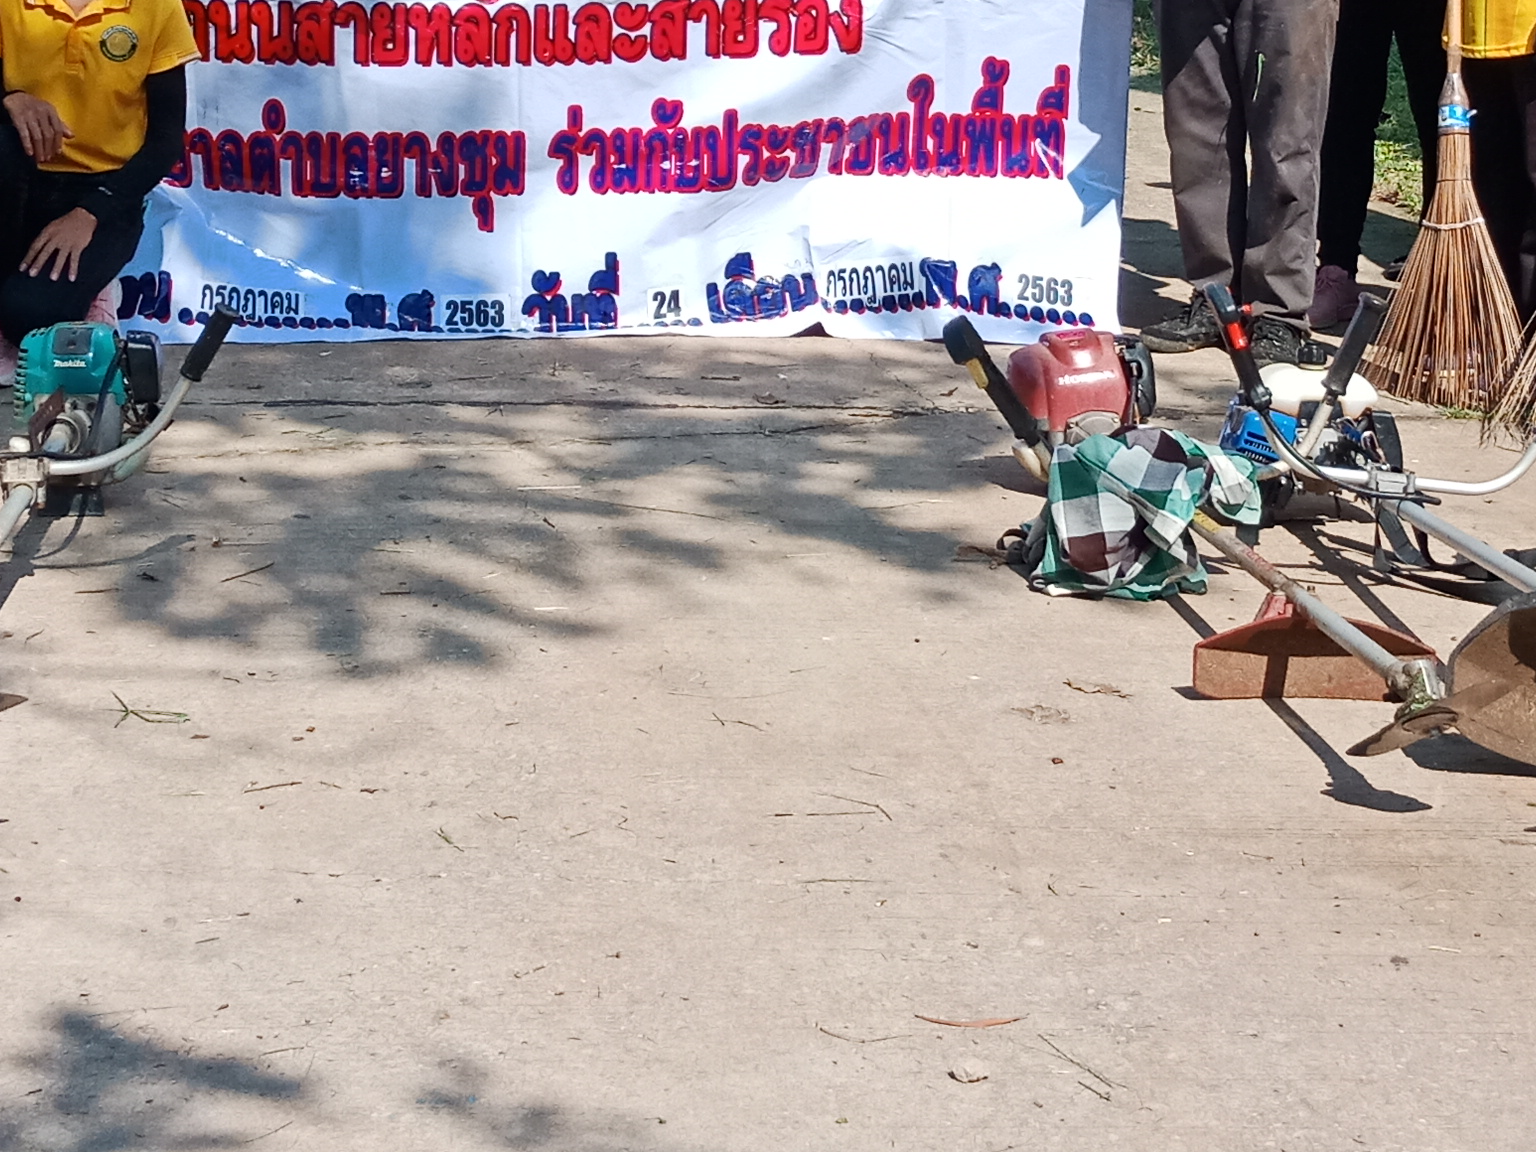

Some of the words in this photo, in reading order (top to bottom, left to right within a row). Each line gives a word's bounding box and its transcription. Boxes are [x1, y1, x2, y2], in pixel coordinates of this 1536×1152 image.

[445, 298, 505, 328] 2563
[521, 252, 621, 333] วันที่
[652, 289, 682, 319] 24
[826, 260, 915, 305] กรกฎาคม
[1017, 273, 1074, 307] 2563
